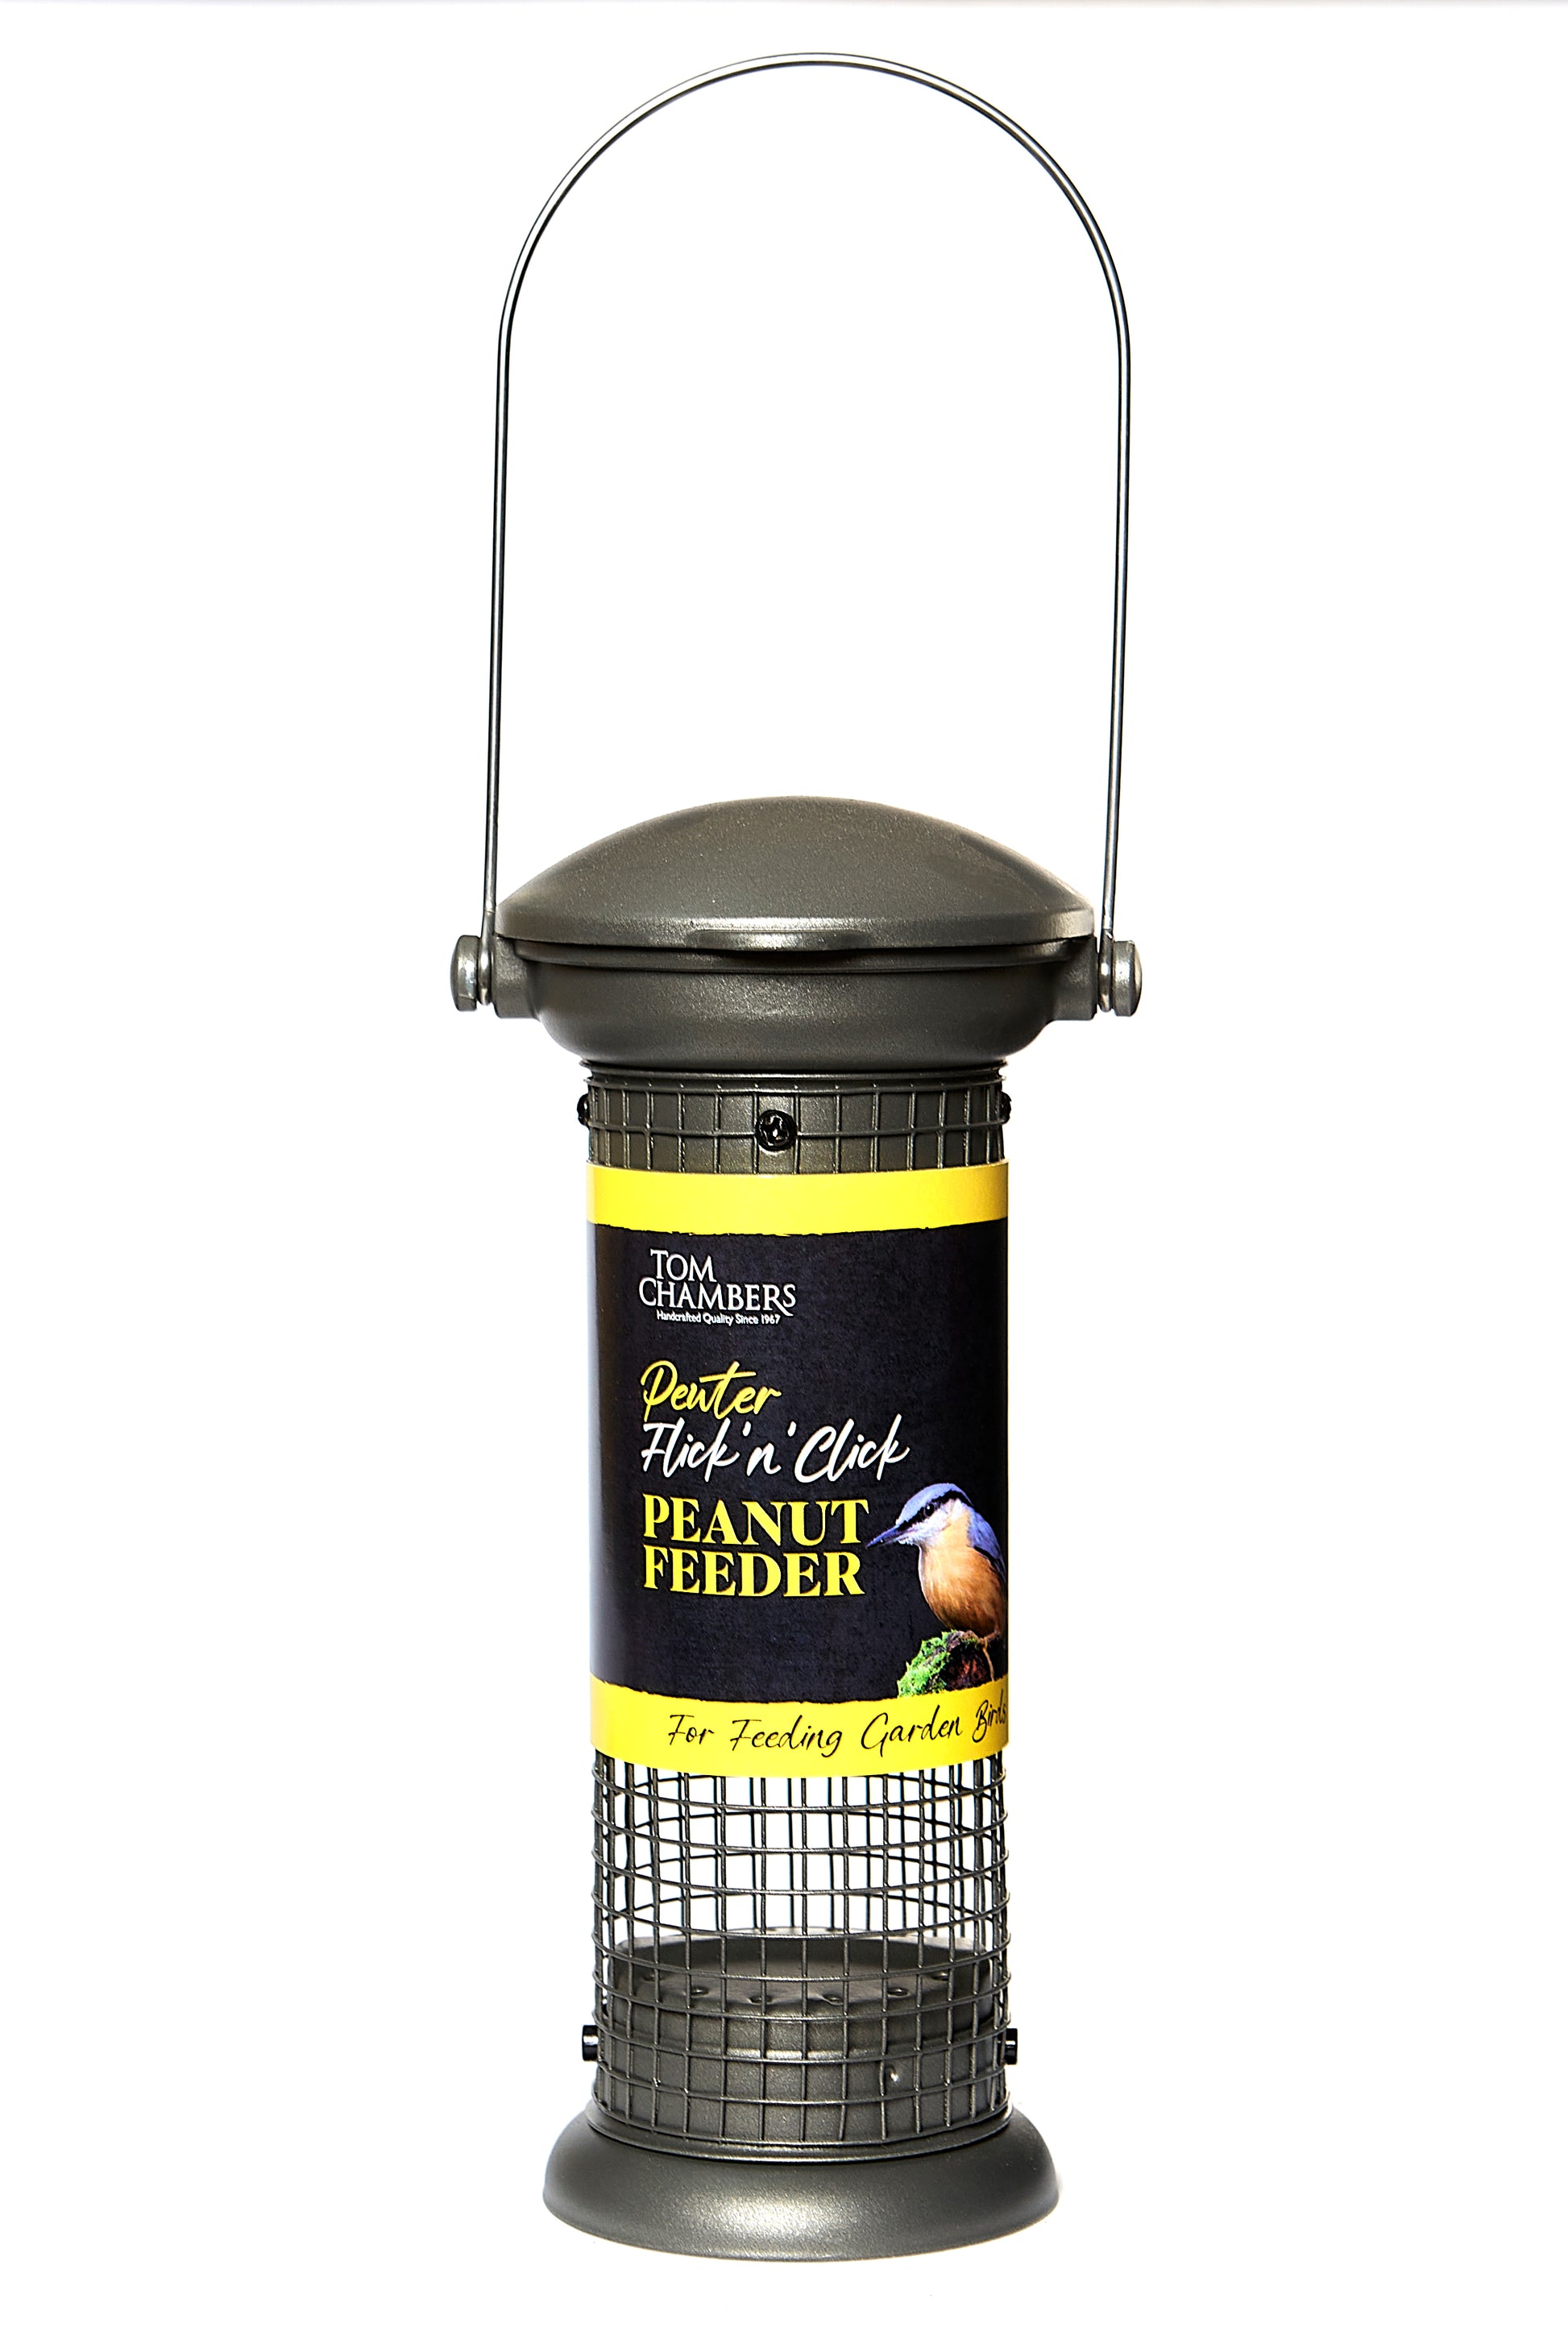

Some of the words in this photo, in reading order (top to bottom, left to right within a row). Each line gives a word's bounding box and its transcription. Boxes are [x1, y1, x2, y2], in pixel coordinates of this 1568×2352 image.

[650, 1249, 717, 1282] TOM
[639, 1276, 796, 1316] CHAMBERS
[656, 1309, 702, 1323] Handcrafted
[703, 1312, 734, 1326] Quality
[735, 1313, 759, 1325] Since
[761, 1314, 781, 1325] 1967
[641, 1360, 782, 1422] Pewter
[642, 1493, 869, 1546] PEANUT
[643, 1544, 865, 1597] FEEDER
[668, 1714, 715, 1745] For
[730, 1715, 843, 1757] Feeding
[861, 1705, 963, 1757] Garden
